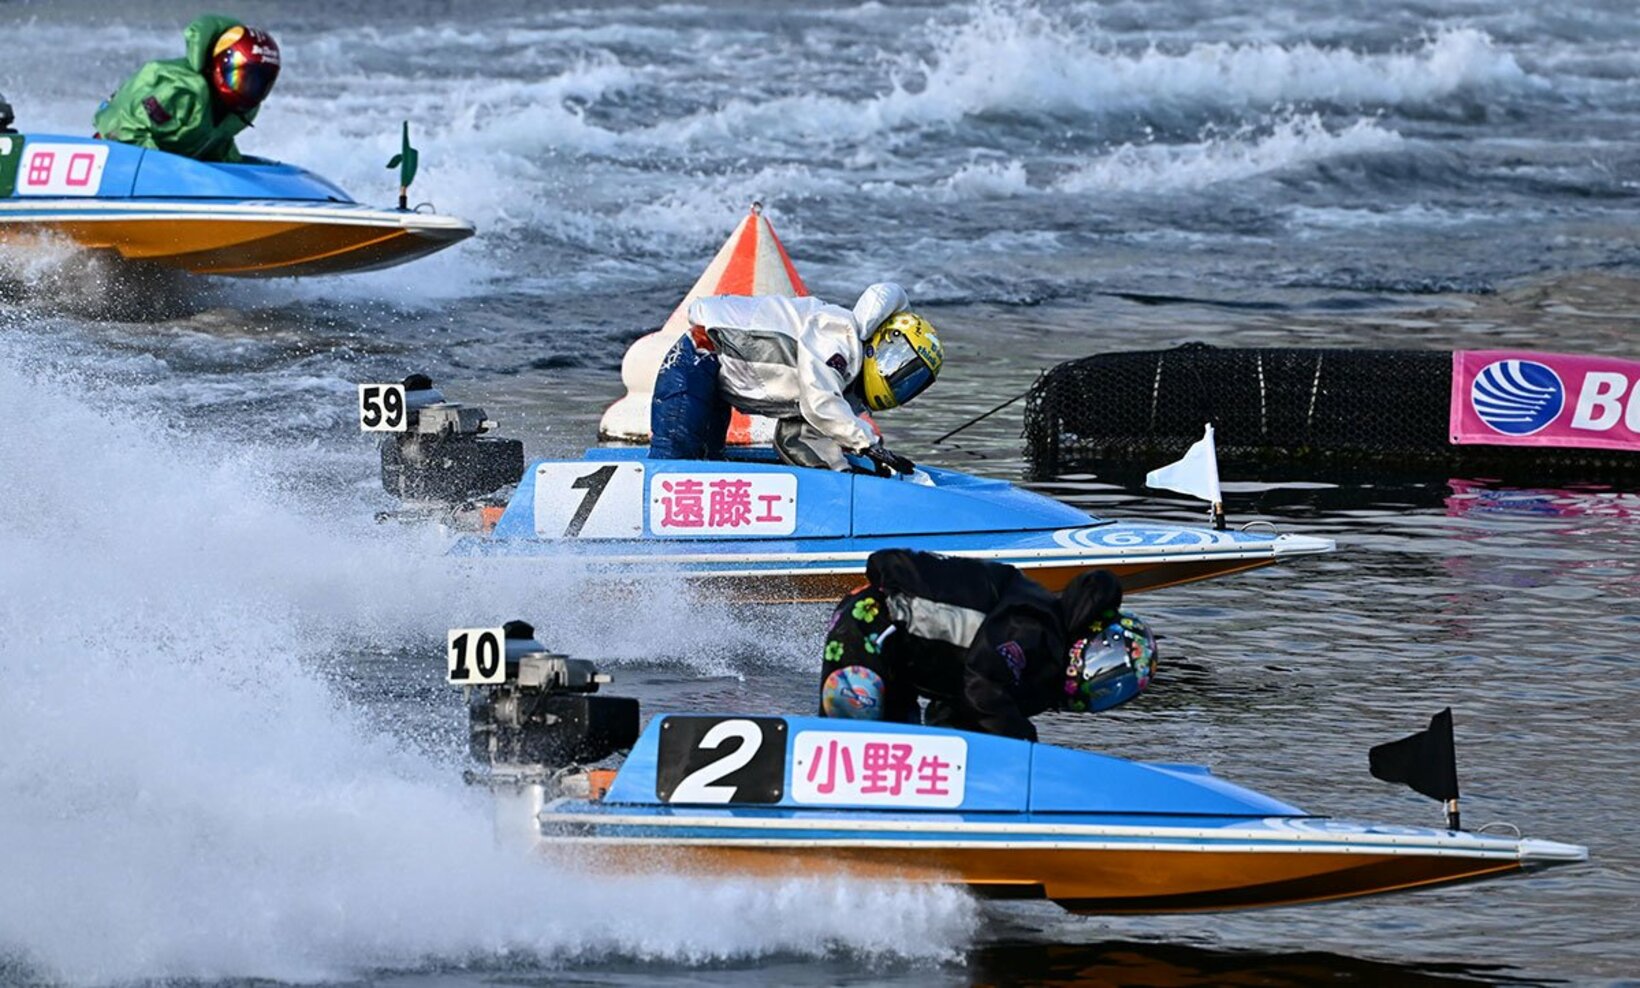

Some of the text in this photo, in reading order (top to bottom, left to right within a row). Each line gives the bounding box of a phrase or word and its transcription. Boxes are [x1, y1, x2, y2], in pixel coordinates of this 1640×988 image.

[27, 152, 96, 187] 田口
[362, 388, 402, 427] 59
[563, 465, 618, 538] 1
[1102, 530, 1180, 545] 67
[450, 632, 500, 680] 10
[668, 718, 764, 804] 2
[806, 739, 950, 797] 小野生
